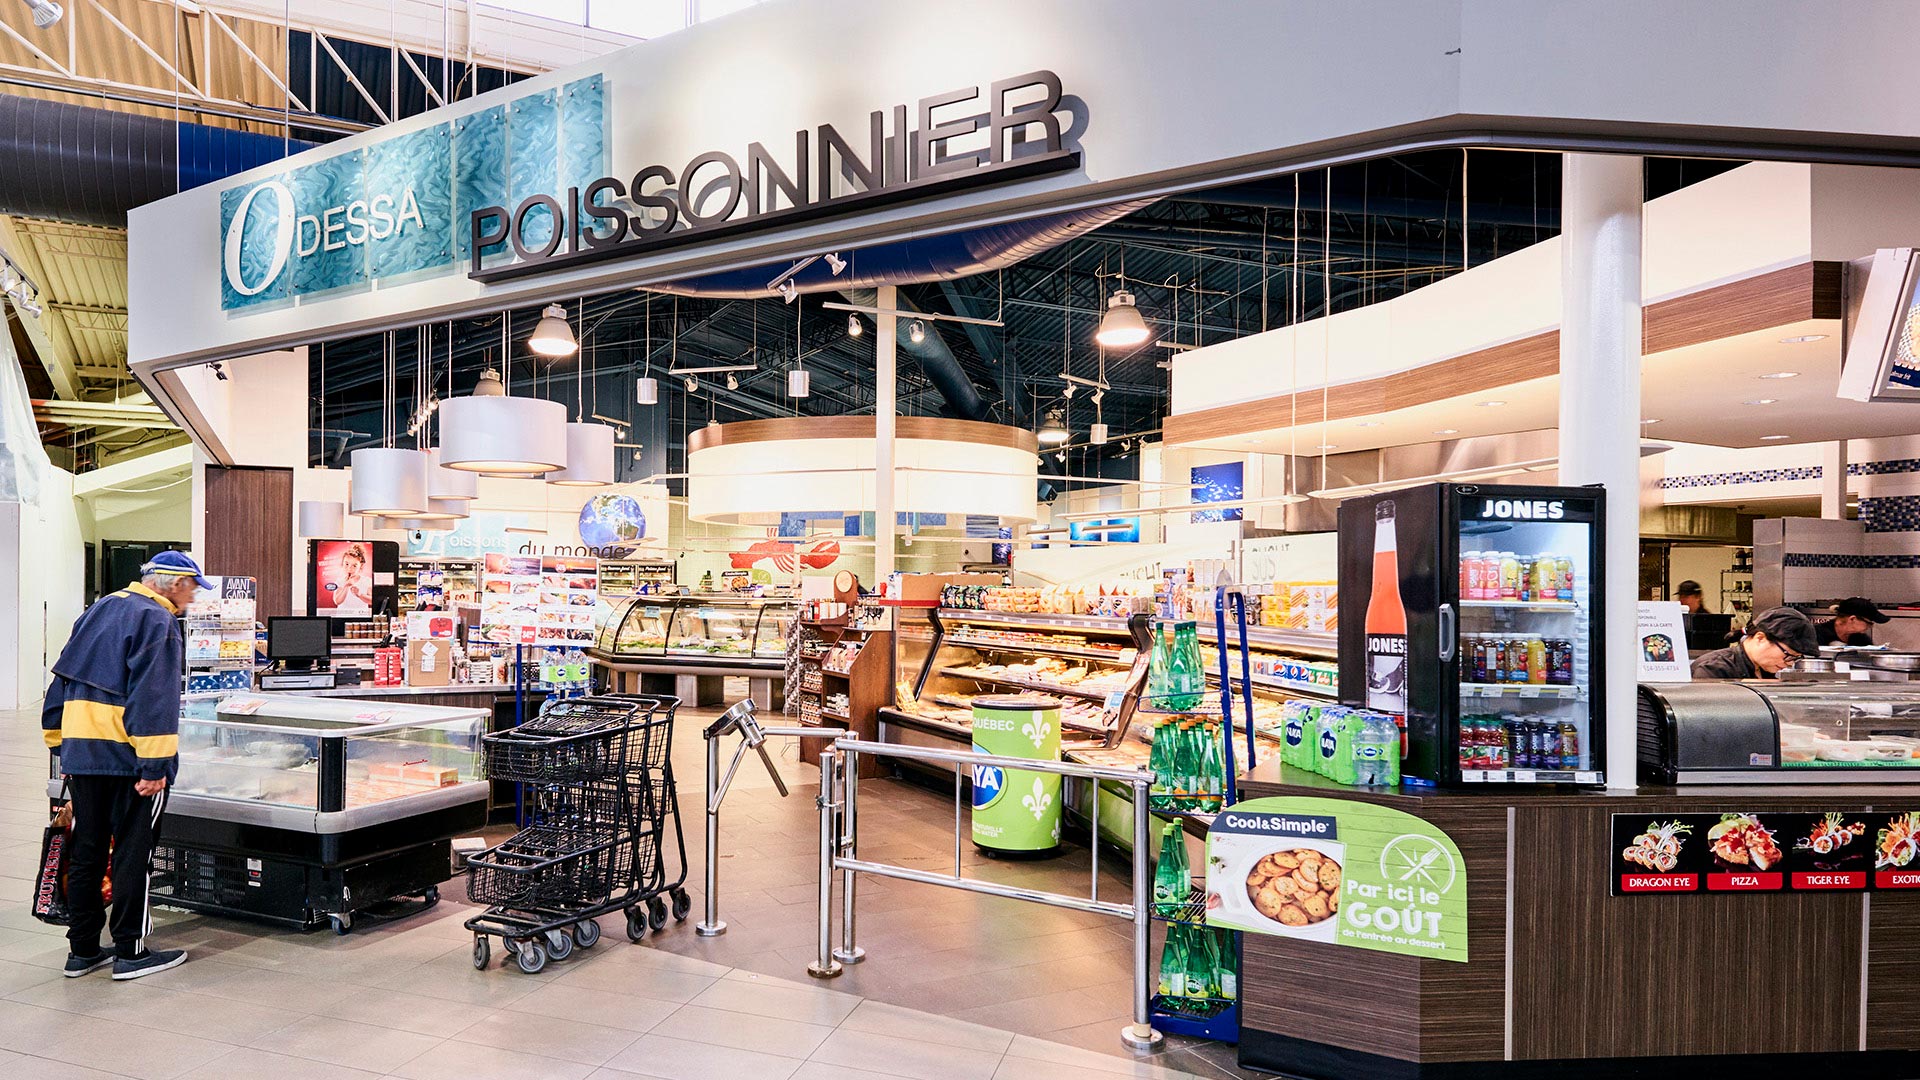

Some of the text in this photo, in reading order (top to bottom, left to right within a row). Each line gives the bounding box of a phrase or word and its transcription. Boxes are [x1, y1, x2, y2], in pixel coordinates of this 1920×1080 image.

[224, 69, 1064, 296] ODESSA POISSONNIER
[1482, 499, 1564, 519] JONES
[519, 541, 625, 559] du monde
[226, 578, 250, 590] AVANT
[1368, 637, 1406, 653] JONES
[972, 763, 1000, 790] YA
[1226, 814, 1328, 834] Cool&Simple
[1629, 877, 1690, 888] DRAGON EYE
[1731, 876, 1759, 886] PIZZA
[1806, 875, 1850, 885] TIGER EYE
[1347, 880, 1440, 905] Par ici le
[1346, 901, 1443, 938] GOÛT
[1342, 929, 1446, 950] de l'entrée au dessert
